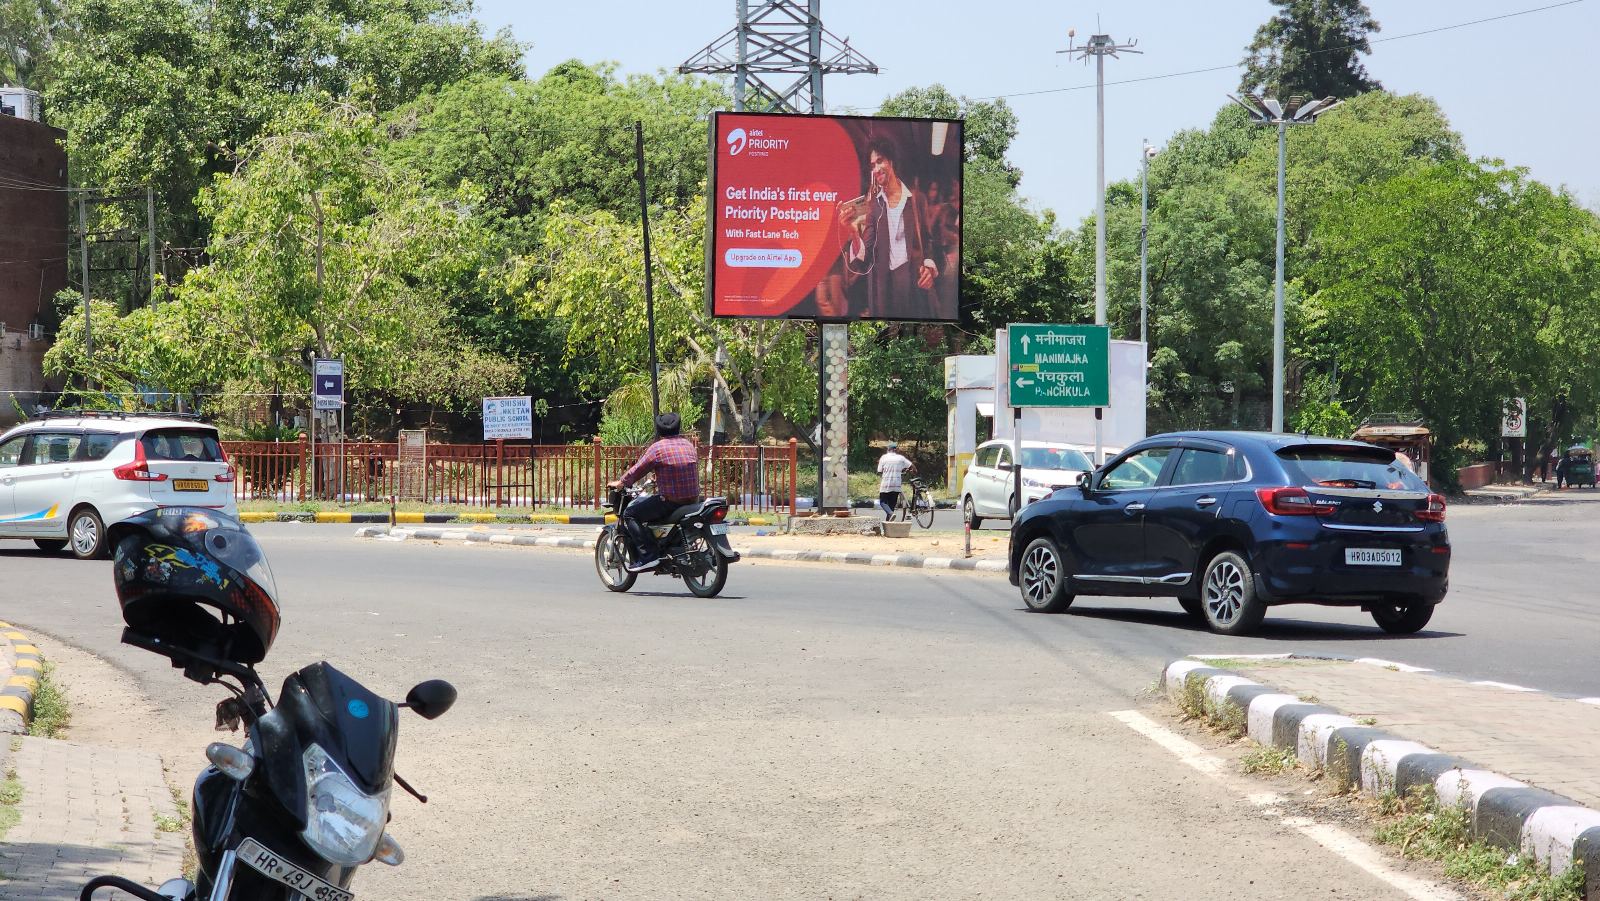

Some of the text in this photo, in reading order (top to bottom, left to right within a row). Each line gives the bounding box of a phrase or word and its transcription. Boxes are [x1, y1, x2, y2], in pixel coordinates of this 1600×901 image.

[748, 139, 789, 149] PRIORITY
[726, 186, 838, 202] Get India's first ever
[725, 205, 820, 223] Priority Postpaid
[725, 229, 799, 239] With Fast Lane Tech
[730, 253, 757, 262] Upgrade
[784, 254, 797, 262] App
[1035, 330, 1087, 346] मनीमाजरा
[1034, 353, 1089, 364] MANIMAJRA
[1036, 369, 1085, 386] पंचकुला
[255, 851, 278, 873] HR
